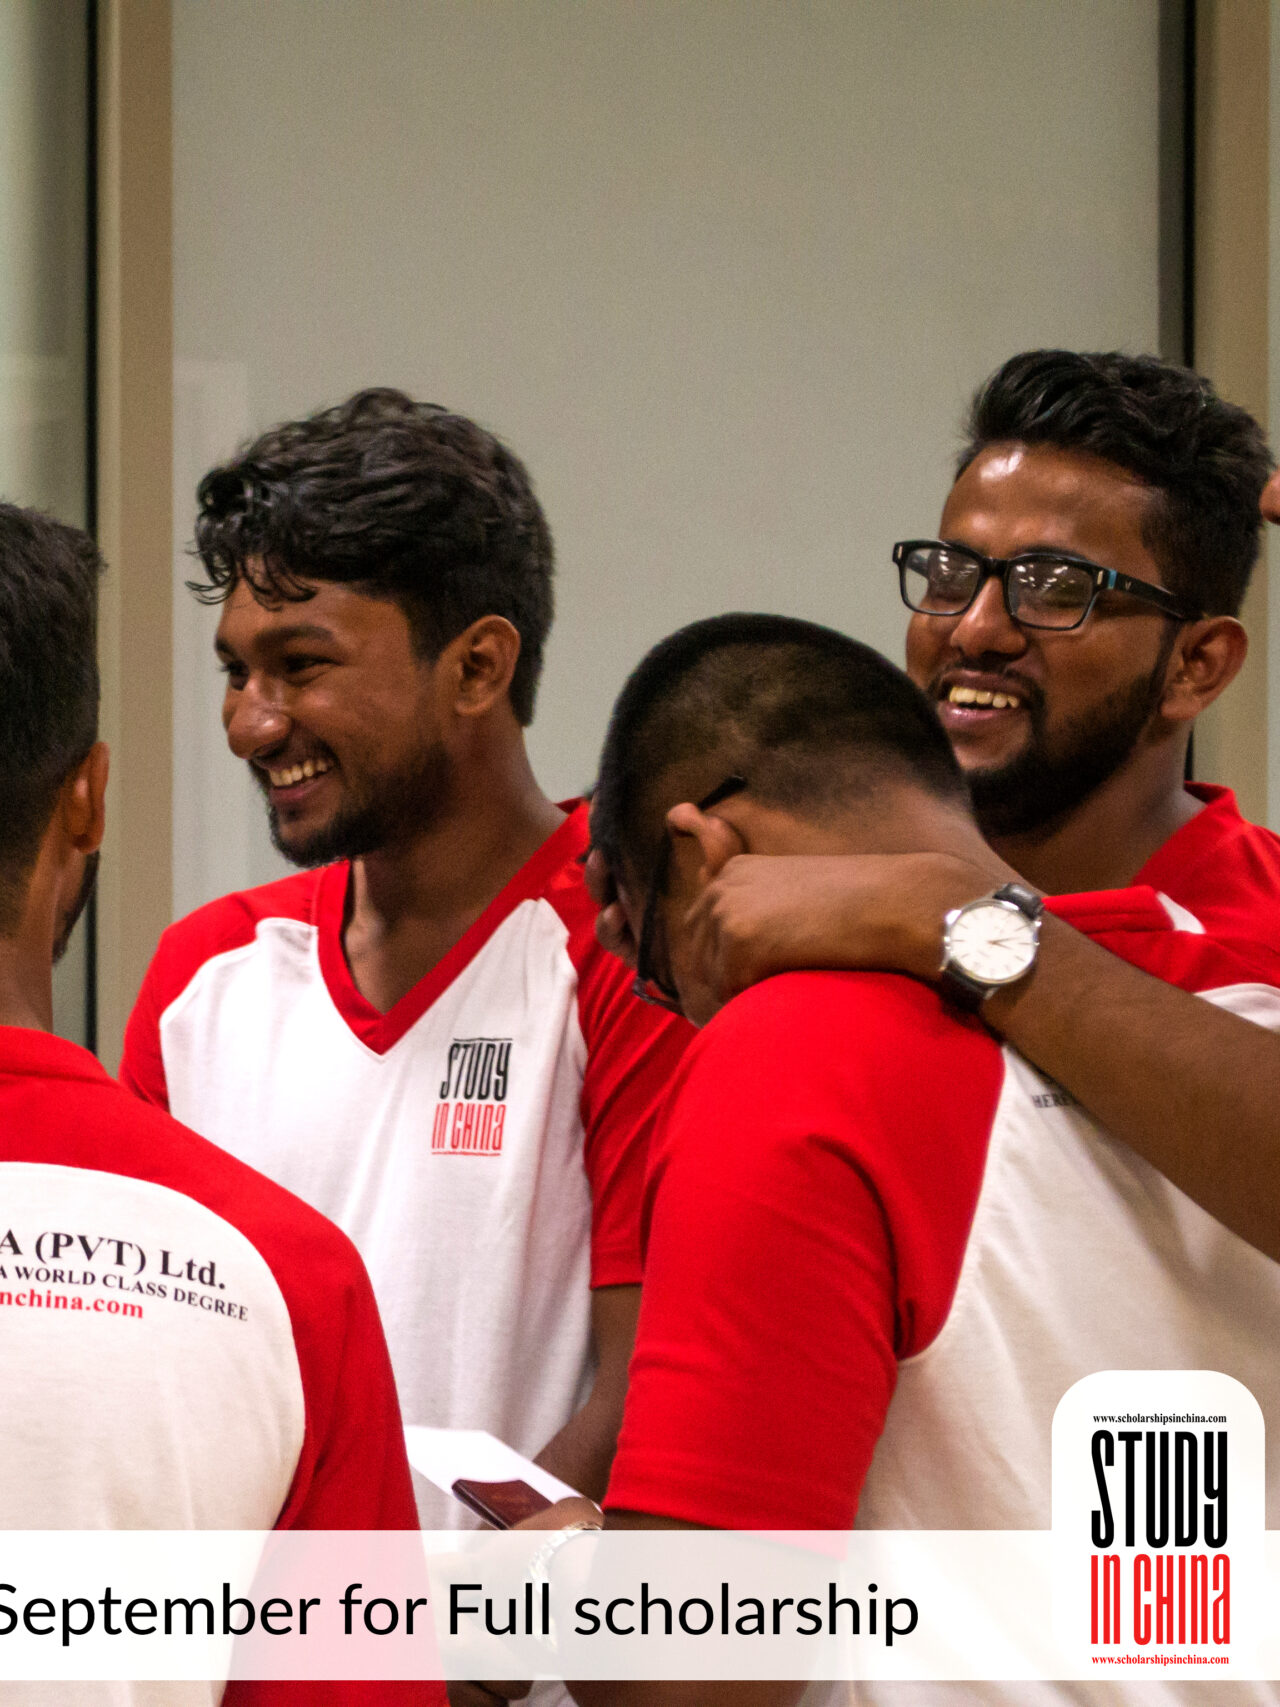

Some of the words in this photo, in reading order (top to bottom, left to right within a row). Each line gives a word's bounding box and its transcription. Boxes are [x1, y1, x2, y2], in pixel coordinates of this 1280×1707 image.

[439, 1042, 512, 1101] STUDY
[35, 1231, 147, 1276] (PVT)
[158, 1249, 227, 1290] Ltd.
[15, 1266, 97, 1286] WORLD
[102, 1273, 168, 1299] CLASS
[173, 1287, 249, 1322] DEGREE
